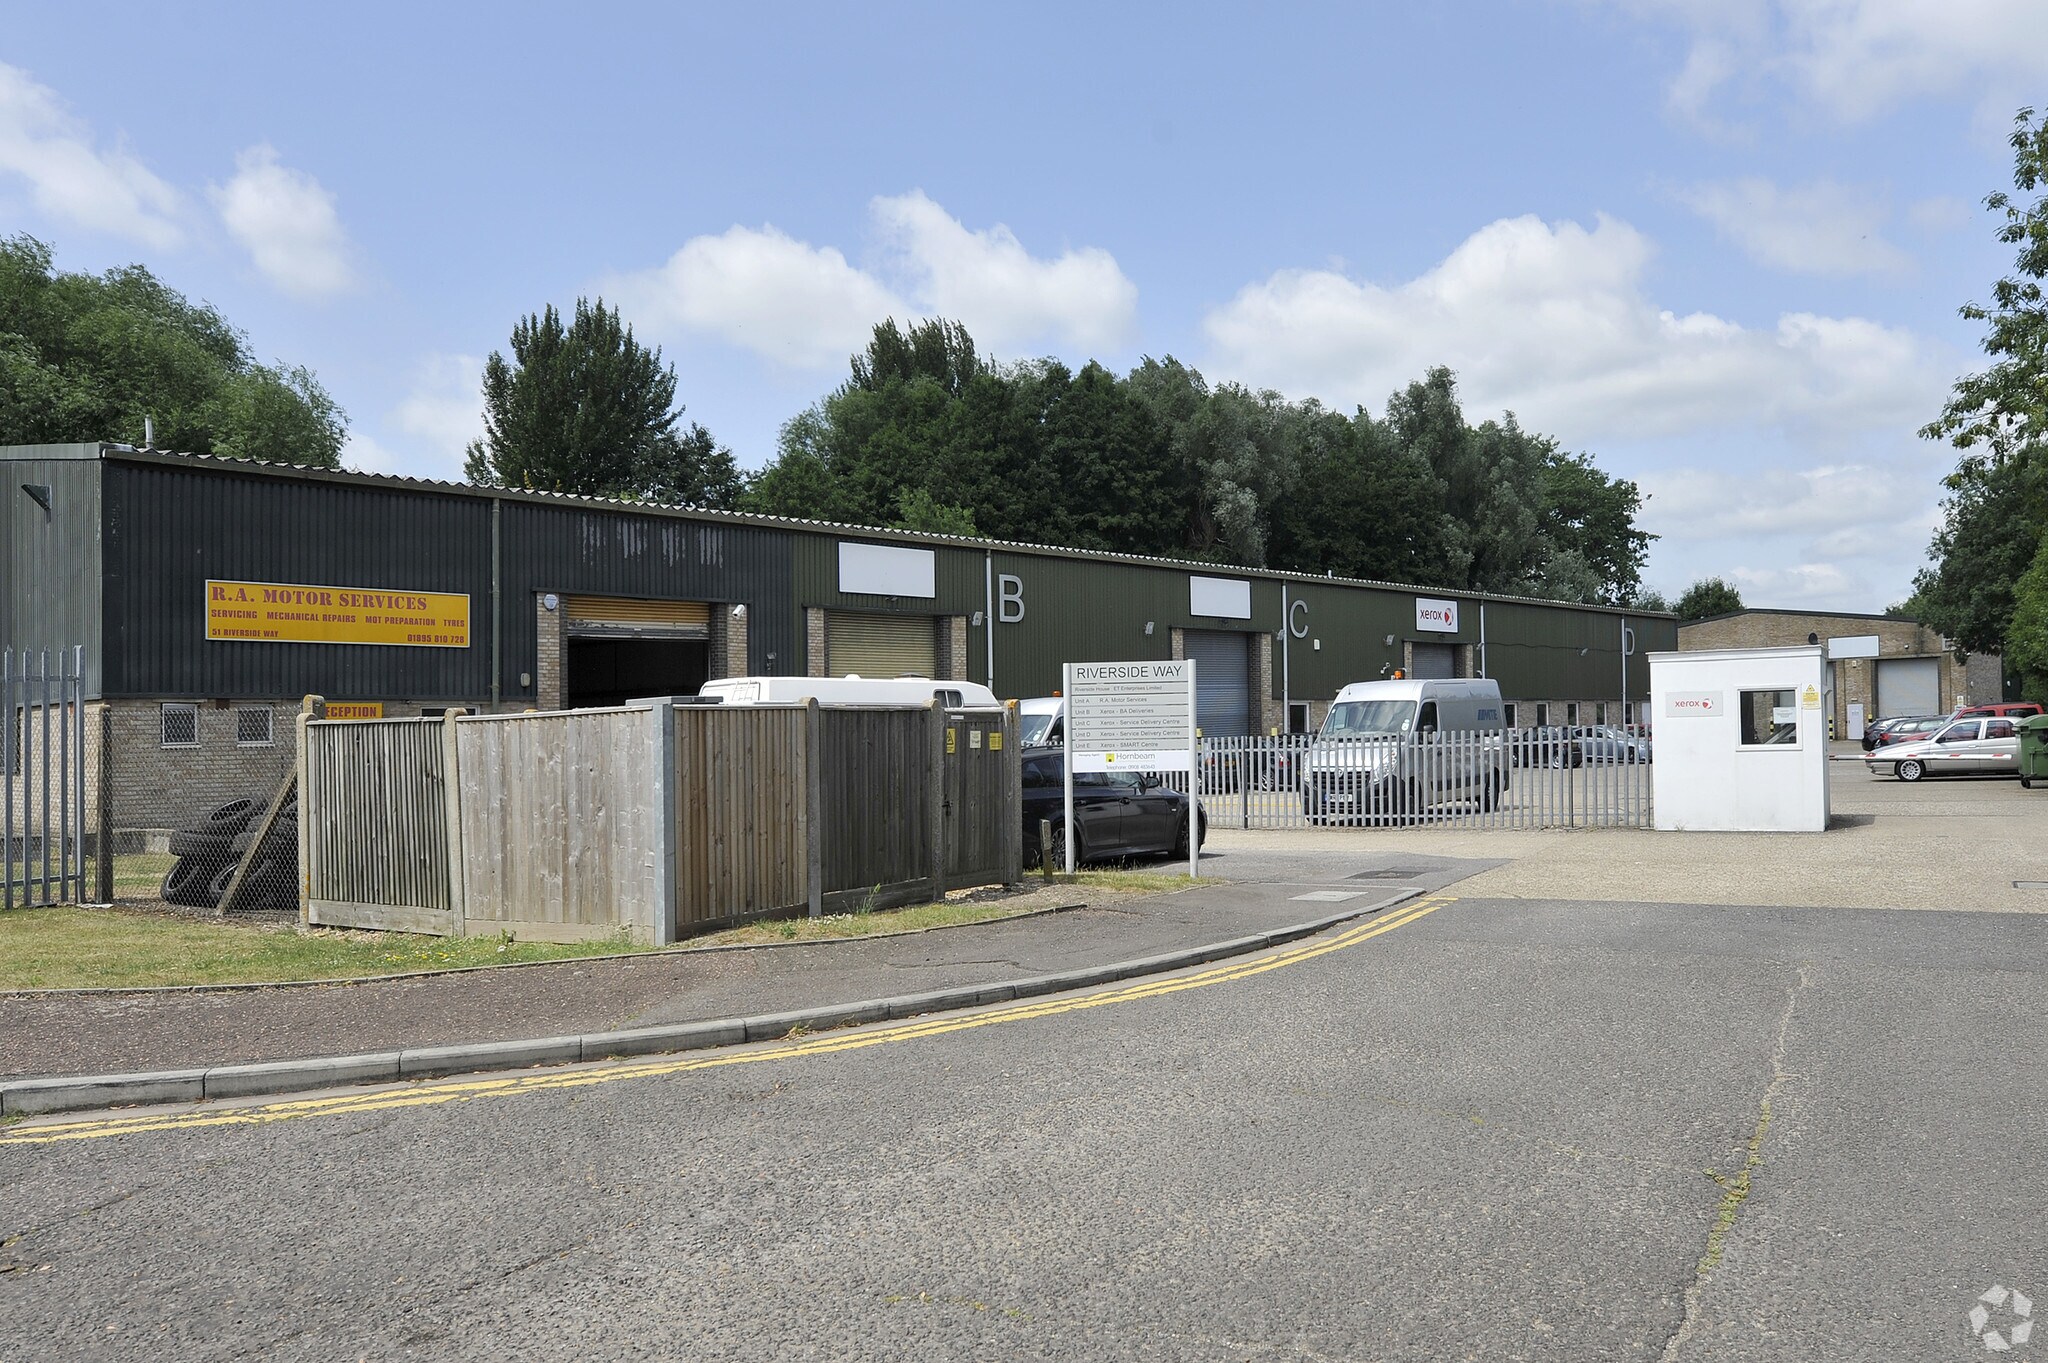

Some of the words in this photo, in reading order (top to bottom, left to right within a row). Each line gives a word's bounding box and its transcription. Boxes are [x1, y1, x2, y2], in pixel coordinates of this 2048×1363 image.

[212, 586, 255, 602] R.A.
[263, 589, 332, 606] MOTOR
[339, 593, 427, 610] SERVICES
[999, 574, 1025, 622] B
[211, 609, 258, 619] SERVICING
[267, 611, 319, 622] MECHANICAL
[322, 614, 356, 623] REPAIRS
[365, 615, 382, 624] MOT
[384, 616, 436, 626] PREPARATION
[444, 619, 465, 628] TYRES
[1290, 600, 1309, 638] C
[1420, 609, 1443, 621] xerox
[212, 628, 221, 636] 51
[223, 629, 261, 637] RIVERSIDE
[263, 630, 279, 638] WAY
[407, 634, 432, 643] 01895
[434, 635, 448, 643] 810
[450, 636, 465, 644] 728
[1625, 628, 1635, 655] D
[1077, 666, 1149, 679] RIVERSIDE
[1152, 665, 1182, 677] WAY
[1675, 699, 1700, 708] xerox
[325, 706, 377, 717] ECEPTION
